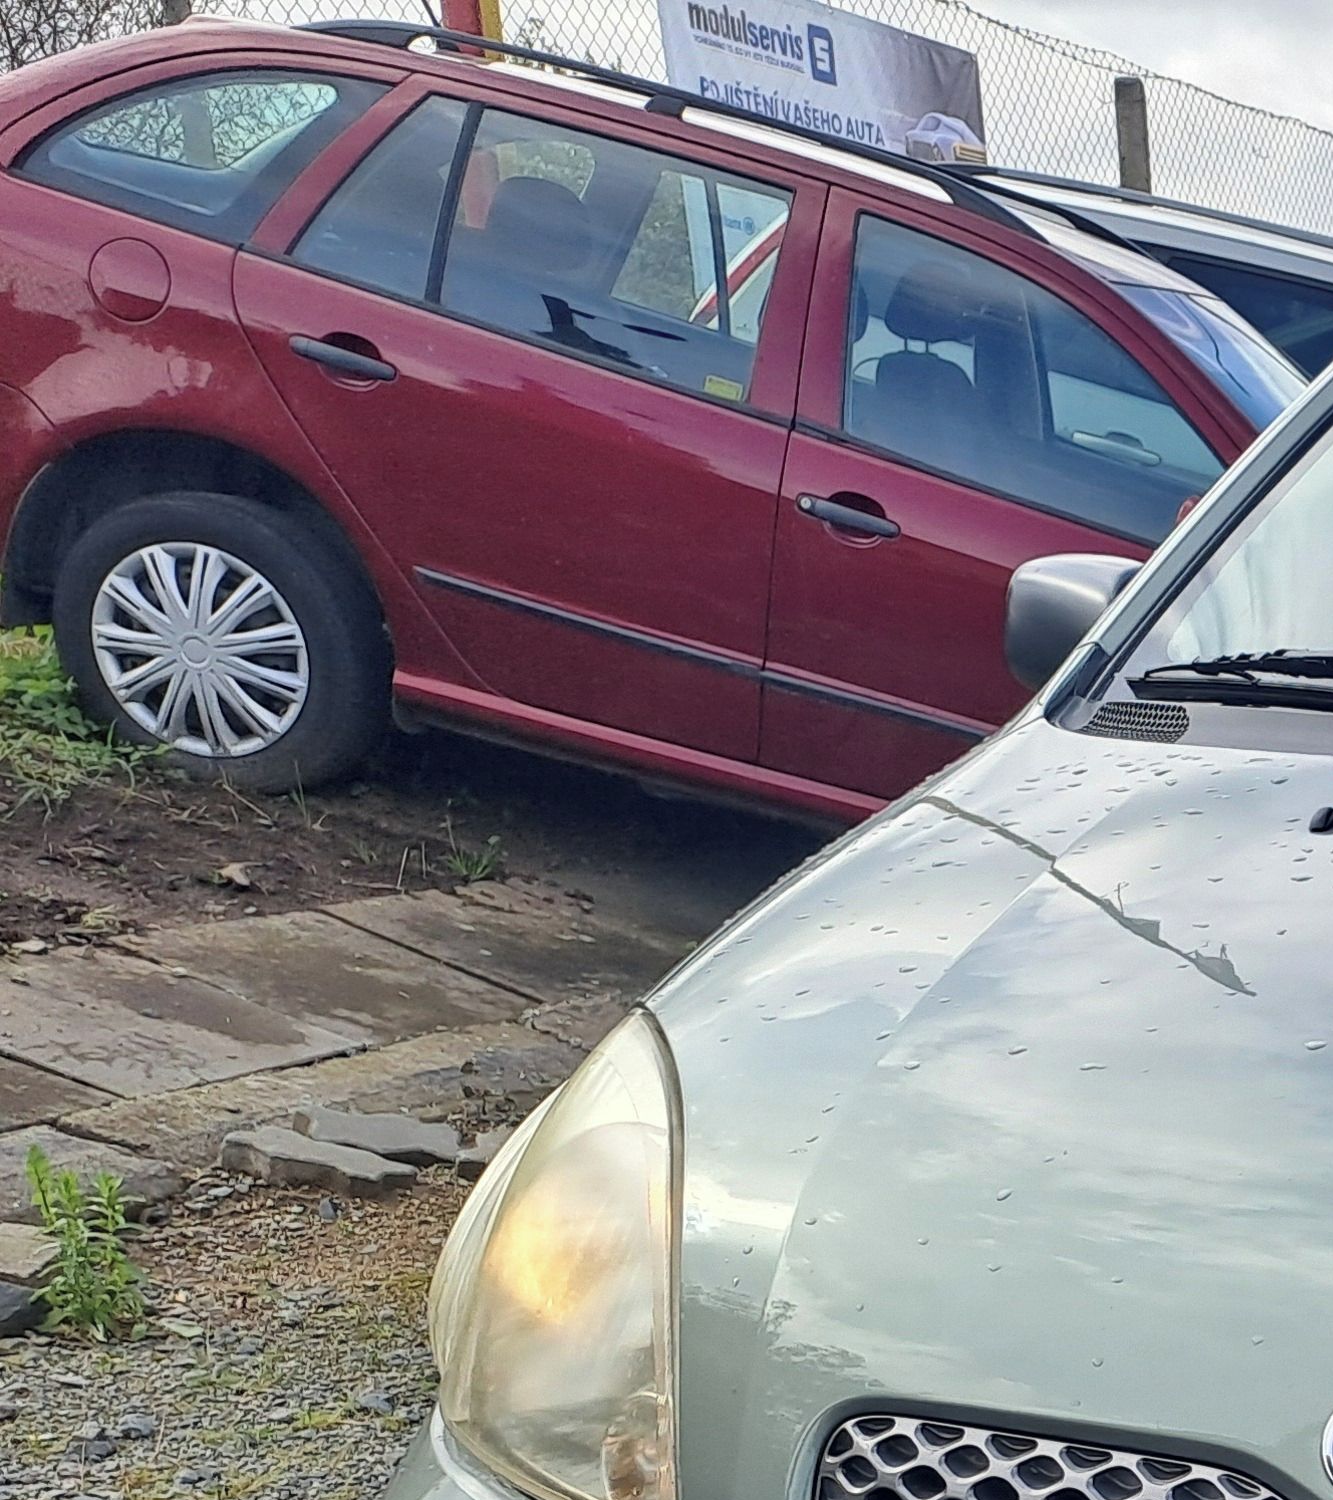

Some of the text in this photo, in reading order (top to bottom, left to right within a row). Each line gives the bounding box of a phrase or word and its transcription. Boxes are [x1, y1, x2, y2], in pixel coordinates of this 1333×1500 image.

[687, 2, 804, 61] modulservis
[781, 99, 843, 135] VAŠEHO
[845, 117, 886, 147] AUTA
